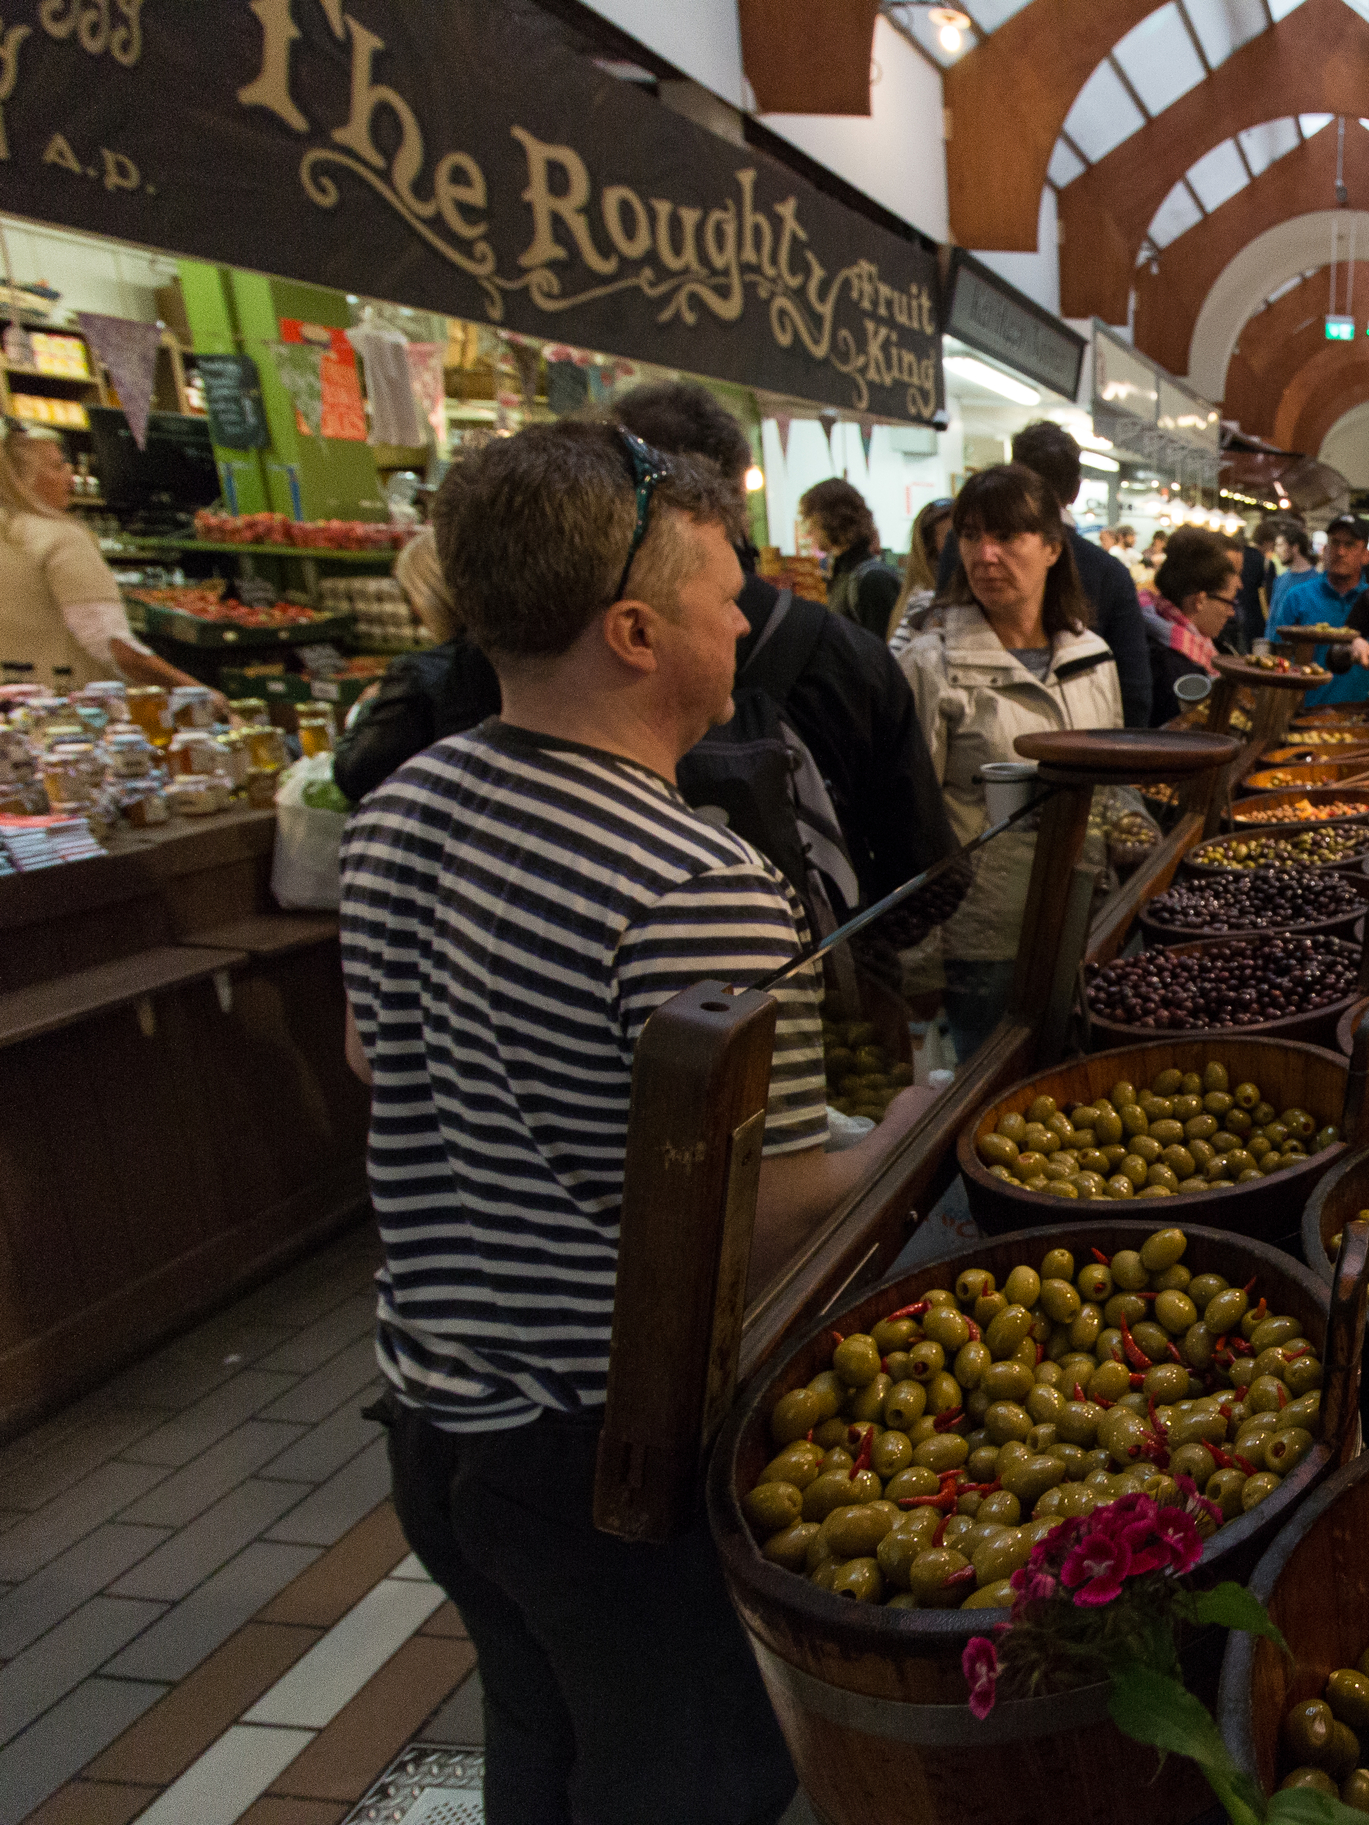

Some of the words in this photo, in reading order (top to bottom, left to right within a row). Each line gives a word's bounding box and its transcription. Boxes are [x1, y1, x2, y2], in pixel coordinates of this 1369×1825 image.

[508, 126, 846, 358] Roughty
[850, 258, 936, 336] Fruit
[857, 318, 938, 420] King
